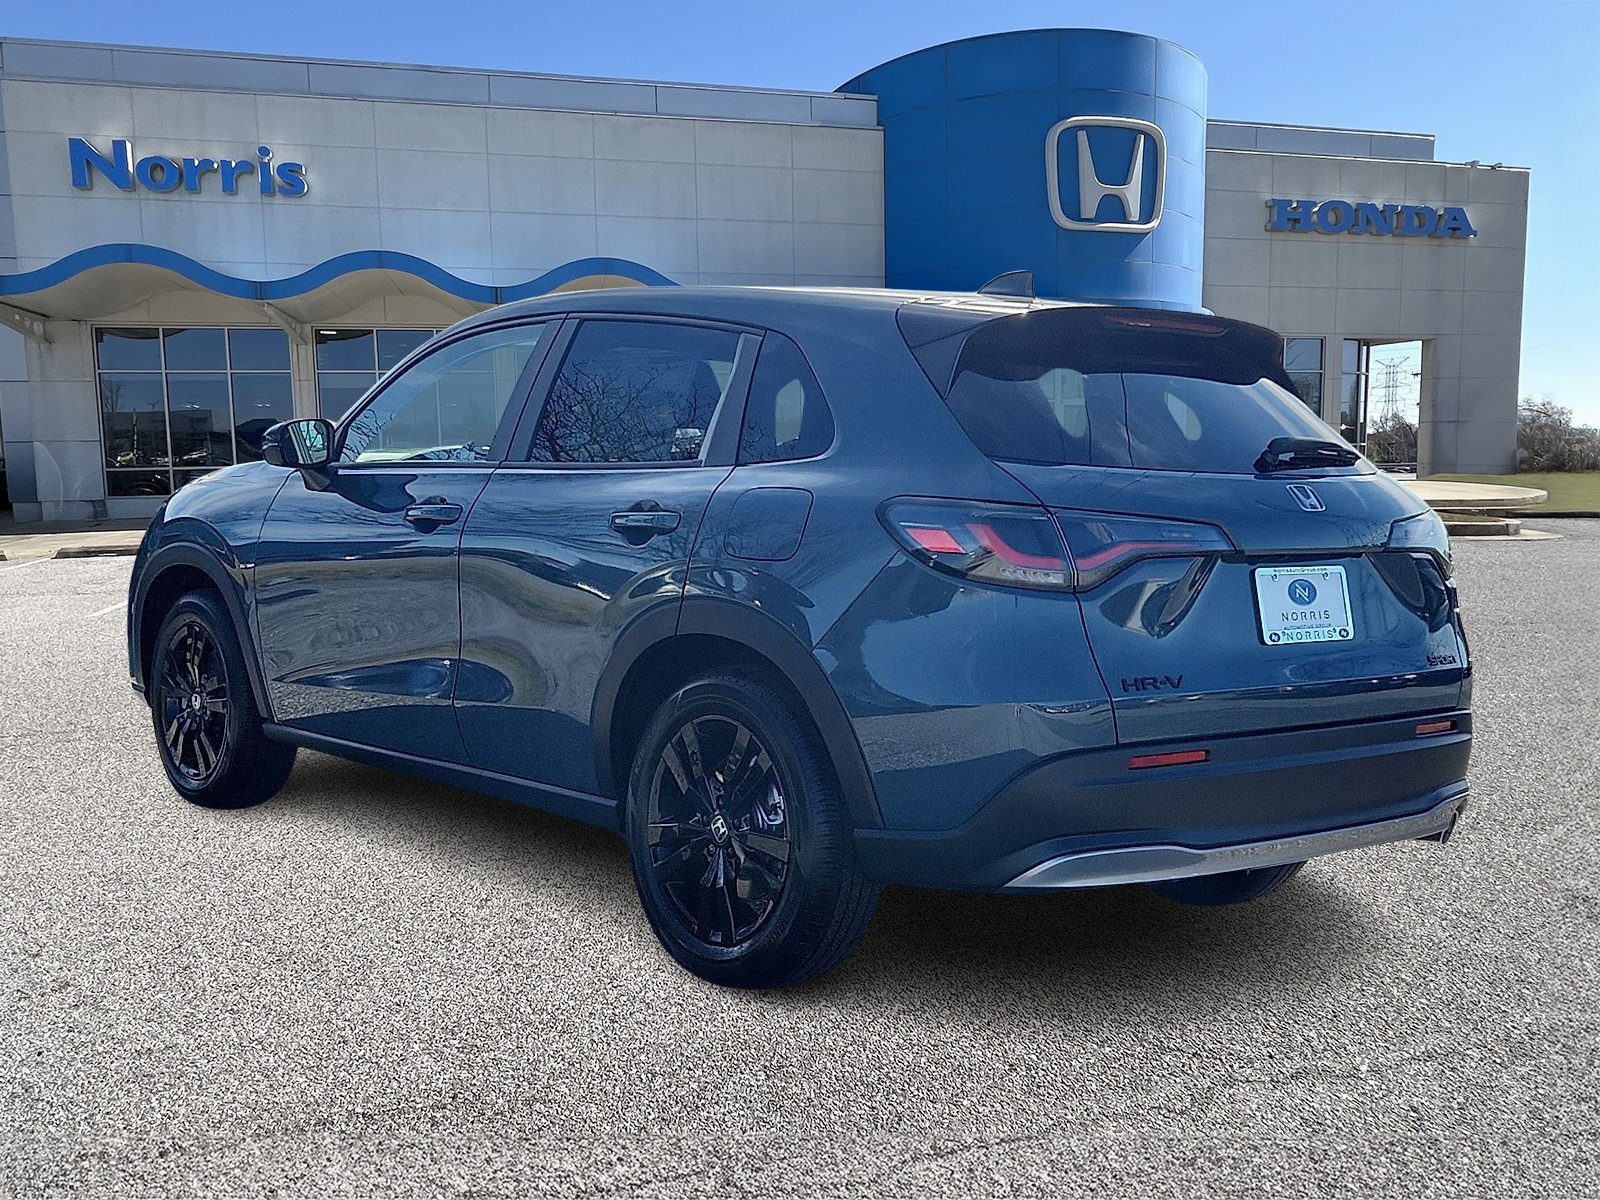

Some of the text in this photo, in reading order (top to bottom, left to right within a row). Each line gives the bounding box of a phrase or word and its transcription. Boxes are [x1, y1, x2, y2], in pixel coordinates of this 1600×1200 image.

[68, 137, 308, 198] Norris
[1265, 198, 1478, 239] HONDA
[1281, 609, 1331, 621] NORRIS
[1286, 629, 1334, 641] NORRIS
[1121, 674, 1184, 693] HR-V
